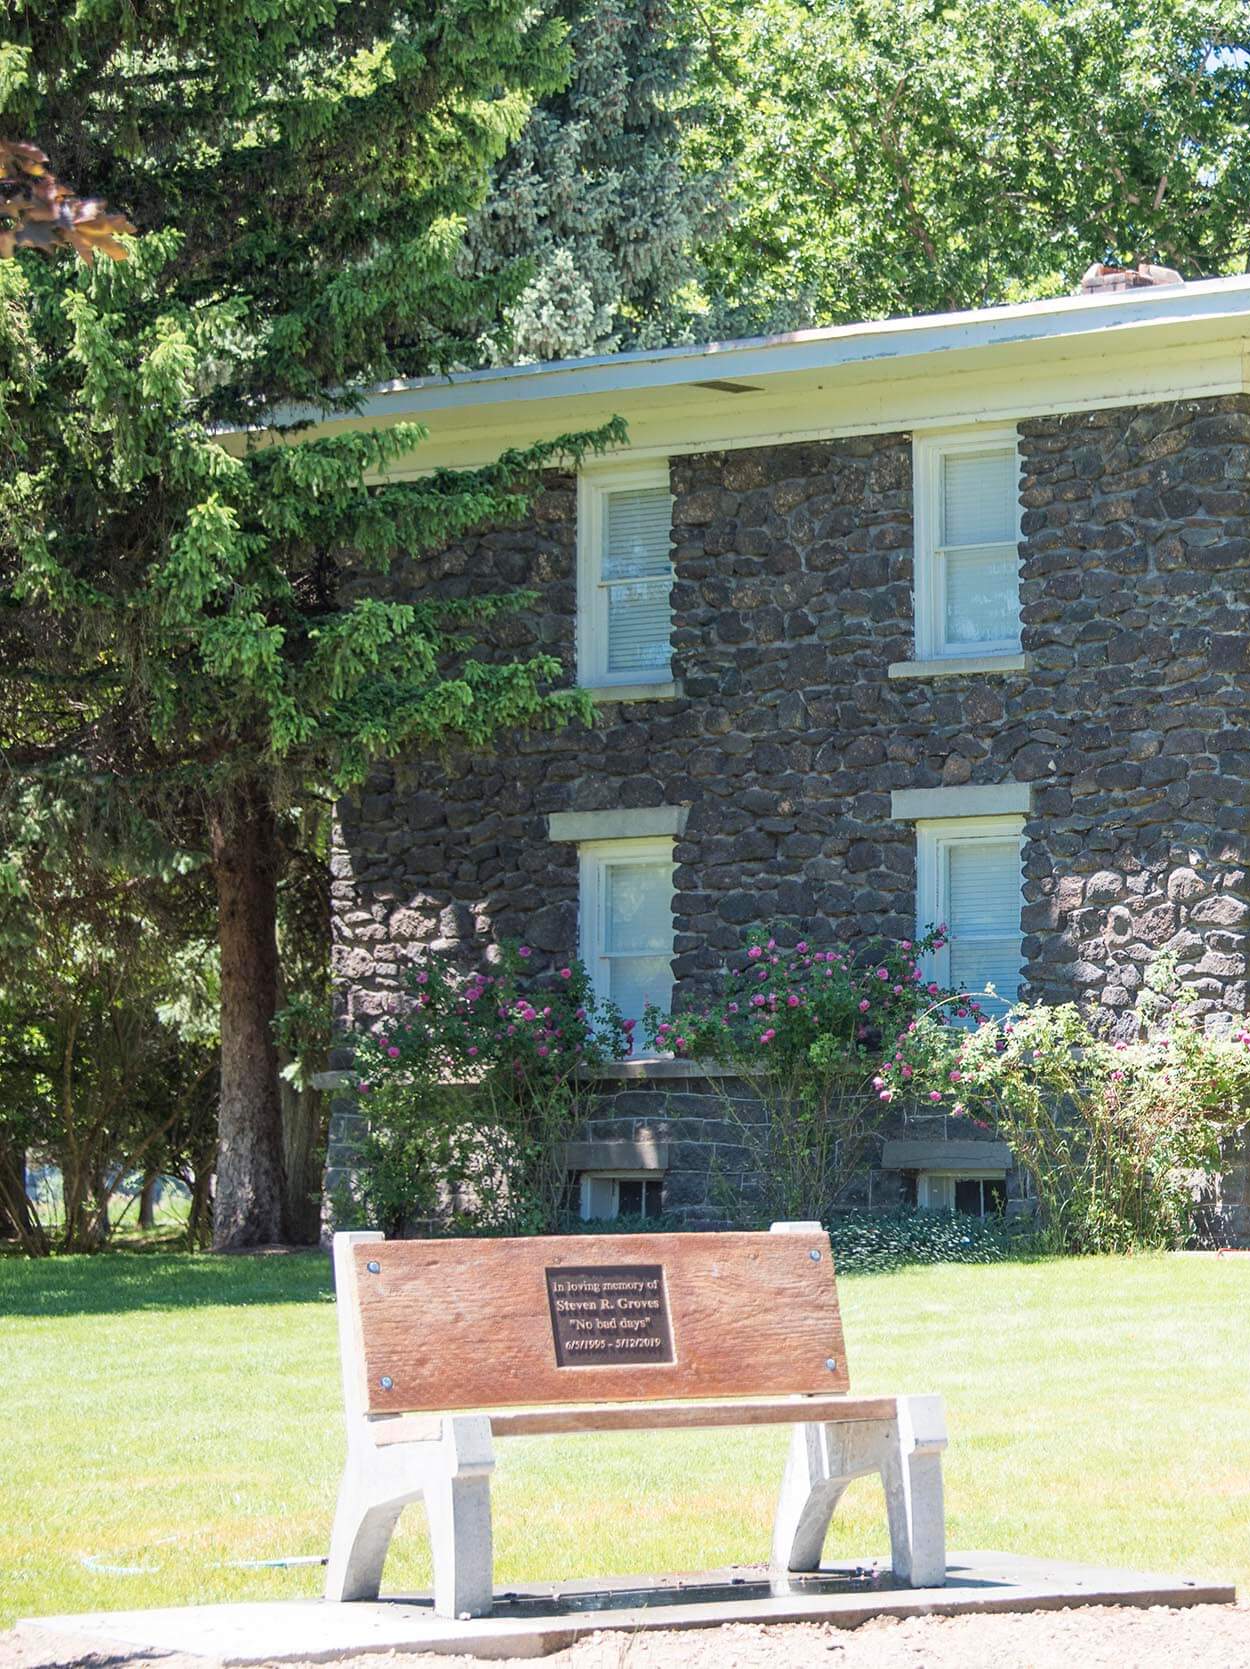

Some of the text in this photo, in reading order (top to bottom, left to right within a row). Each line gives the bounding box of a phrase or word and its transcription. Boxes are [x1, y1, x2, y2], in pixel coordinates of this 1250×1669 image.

[553, 1279, 659, 1293] In loving memory of
[556, 1298, 660, 1311] Steven R. Groves
[569, 1317, 651, 1331] "No bad days"
[615, 1338, 661, 1349] 5/12/2019
